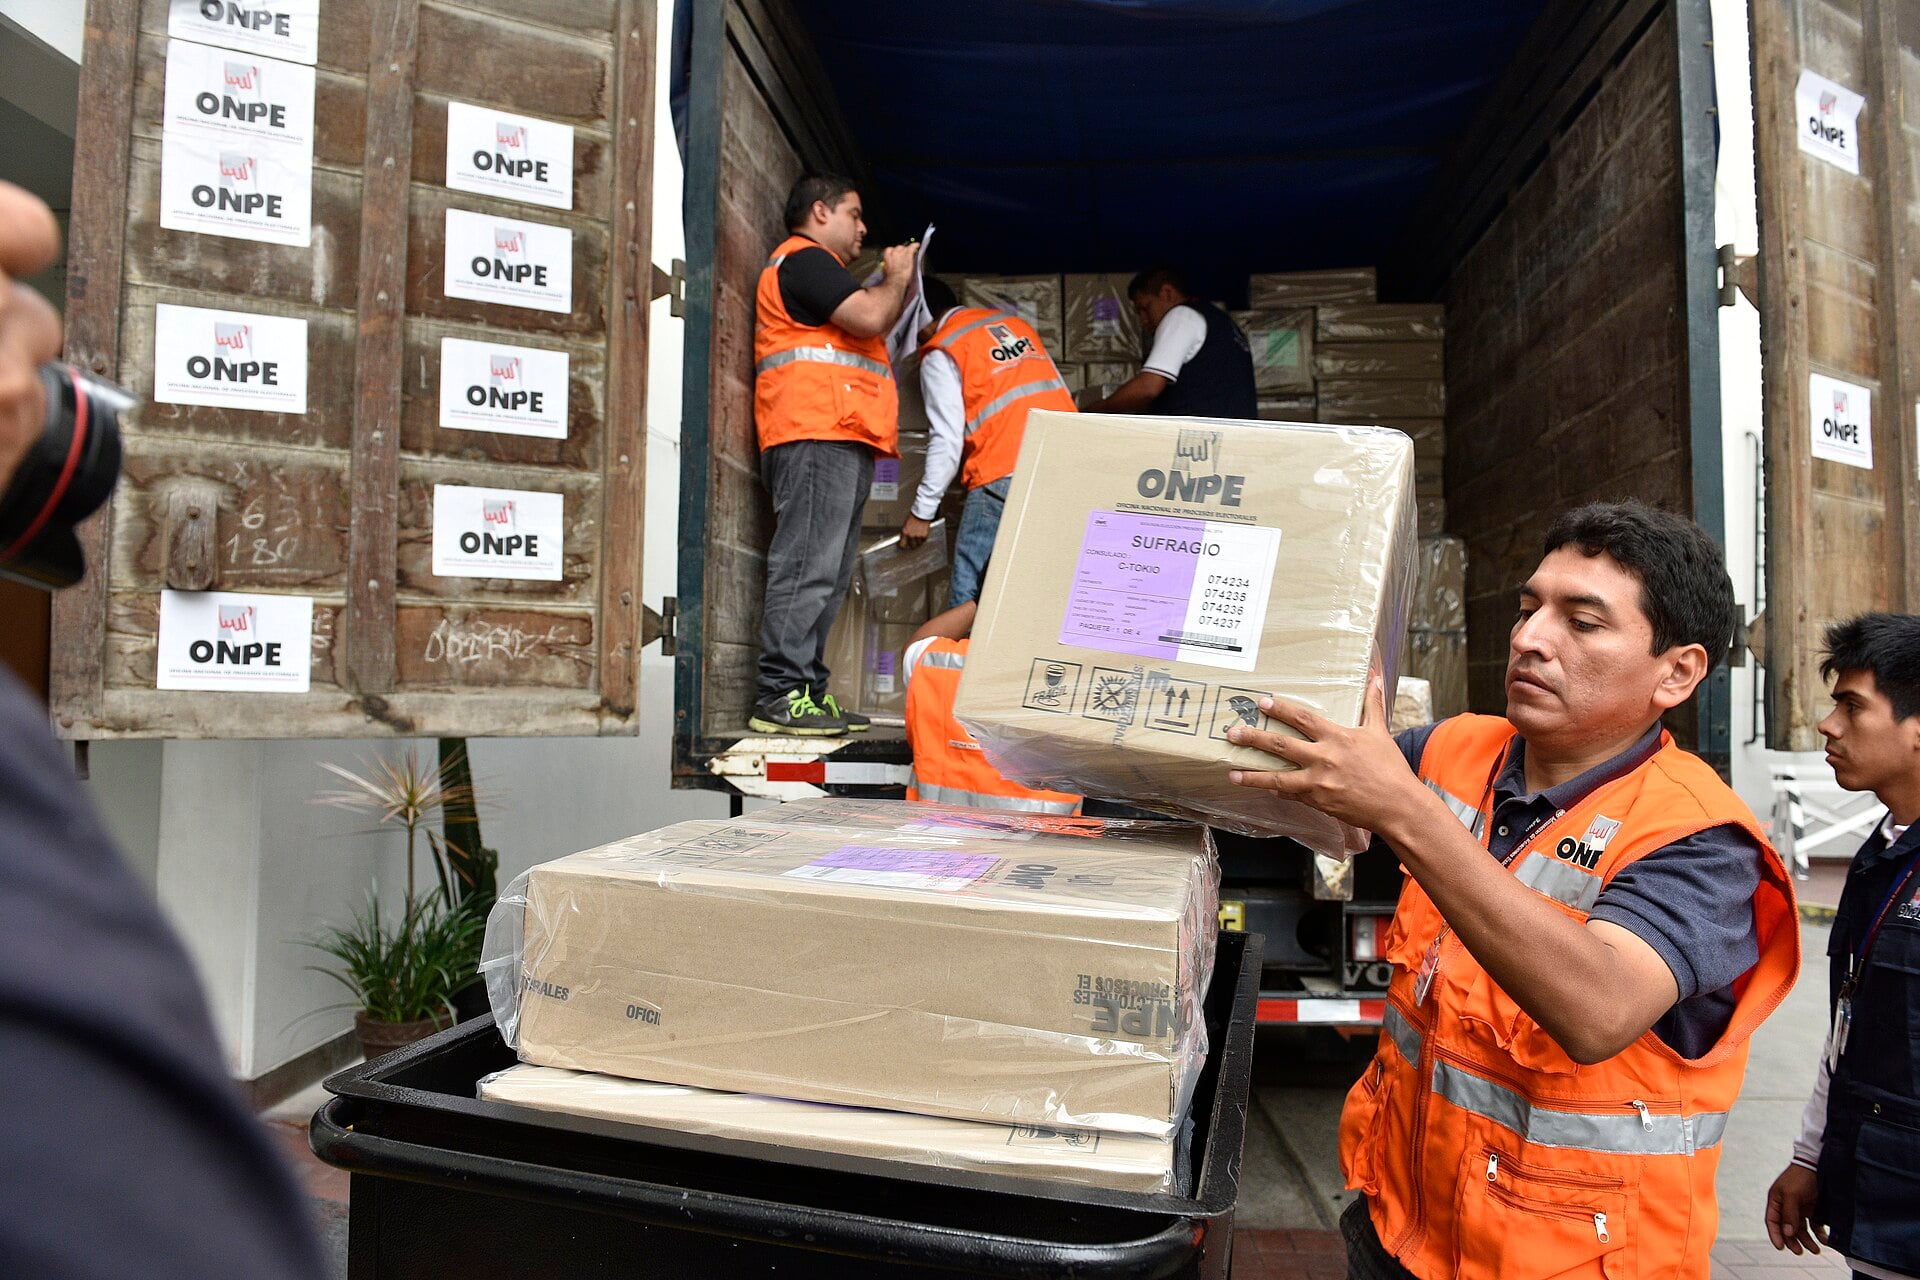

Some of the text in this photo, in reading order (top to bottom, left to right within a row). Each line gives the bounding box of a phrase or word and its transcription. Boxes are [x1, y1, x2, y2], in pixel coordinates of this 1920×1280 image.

[200, 0, 290, 37] ONPE
[196, 91, 286, 128] ONPE
[1809, 116, 1846, 148] ONPE
[473, 150, 548, 183] ONPE
[191, 184, 282, 219] ONPE
[471, 256, 547, 287] ONPE
[187, 355, 278, 386] ONPE
[467, 385, 543, 413] ONPE
[1823, 418, 1859, 444] ONPE
[1137, 468, 1245, 507] ONPE
[460, 532, 538, 557] ONPE
[1131, 535, 1221, 557] SUFRAGIO
[1118, 562, 1160, 574] C-TOKIO
[1208, 574, 1250, 588] 074234
[1202, 601, 1244, 615] 074236
[1204, 588, 1247, 602] 074235
[1079, 622, 1111, 633] PAQUETE
[1198, 615, 1241, 629] 074237
[189, 640, 281, 666] ONPE
[1032, 684, 1068, 703] FRAGIL
